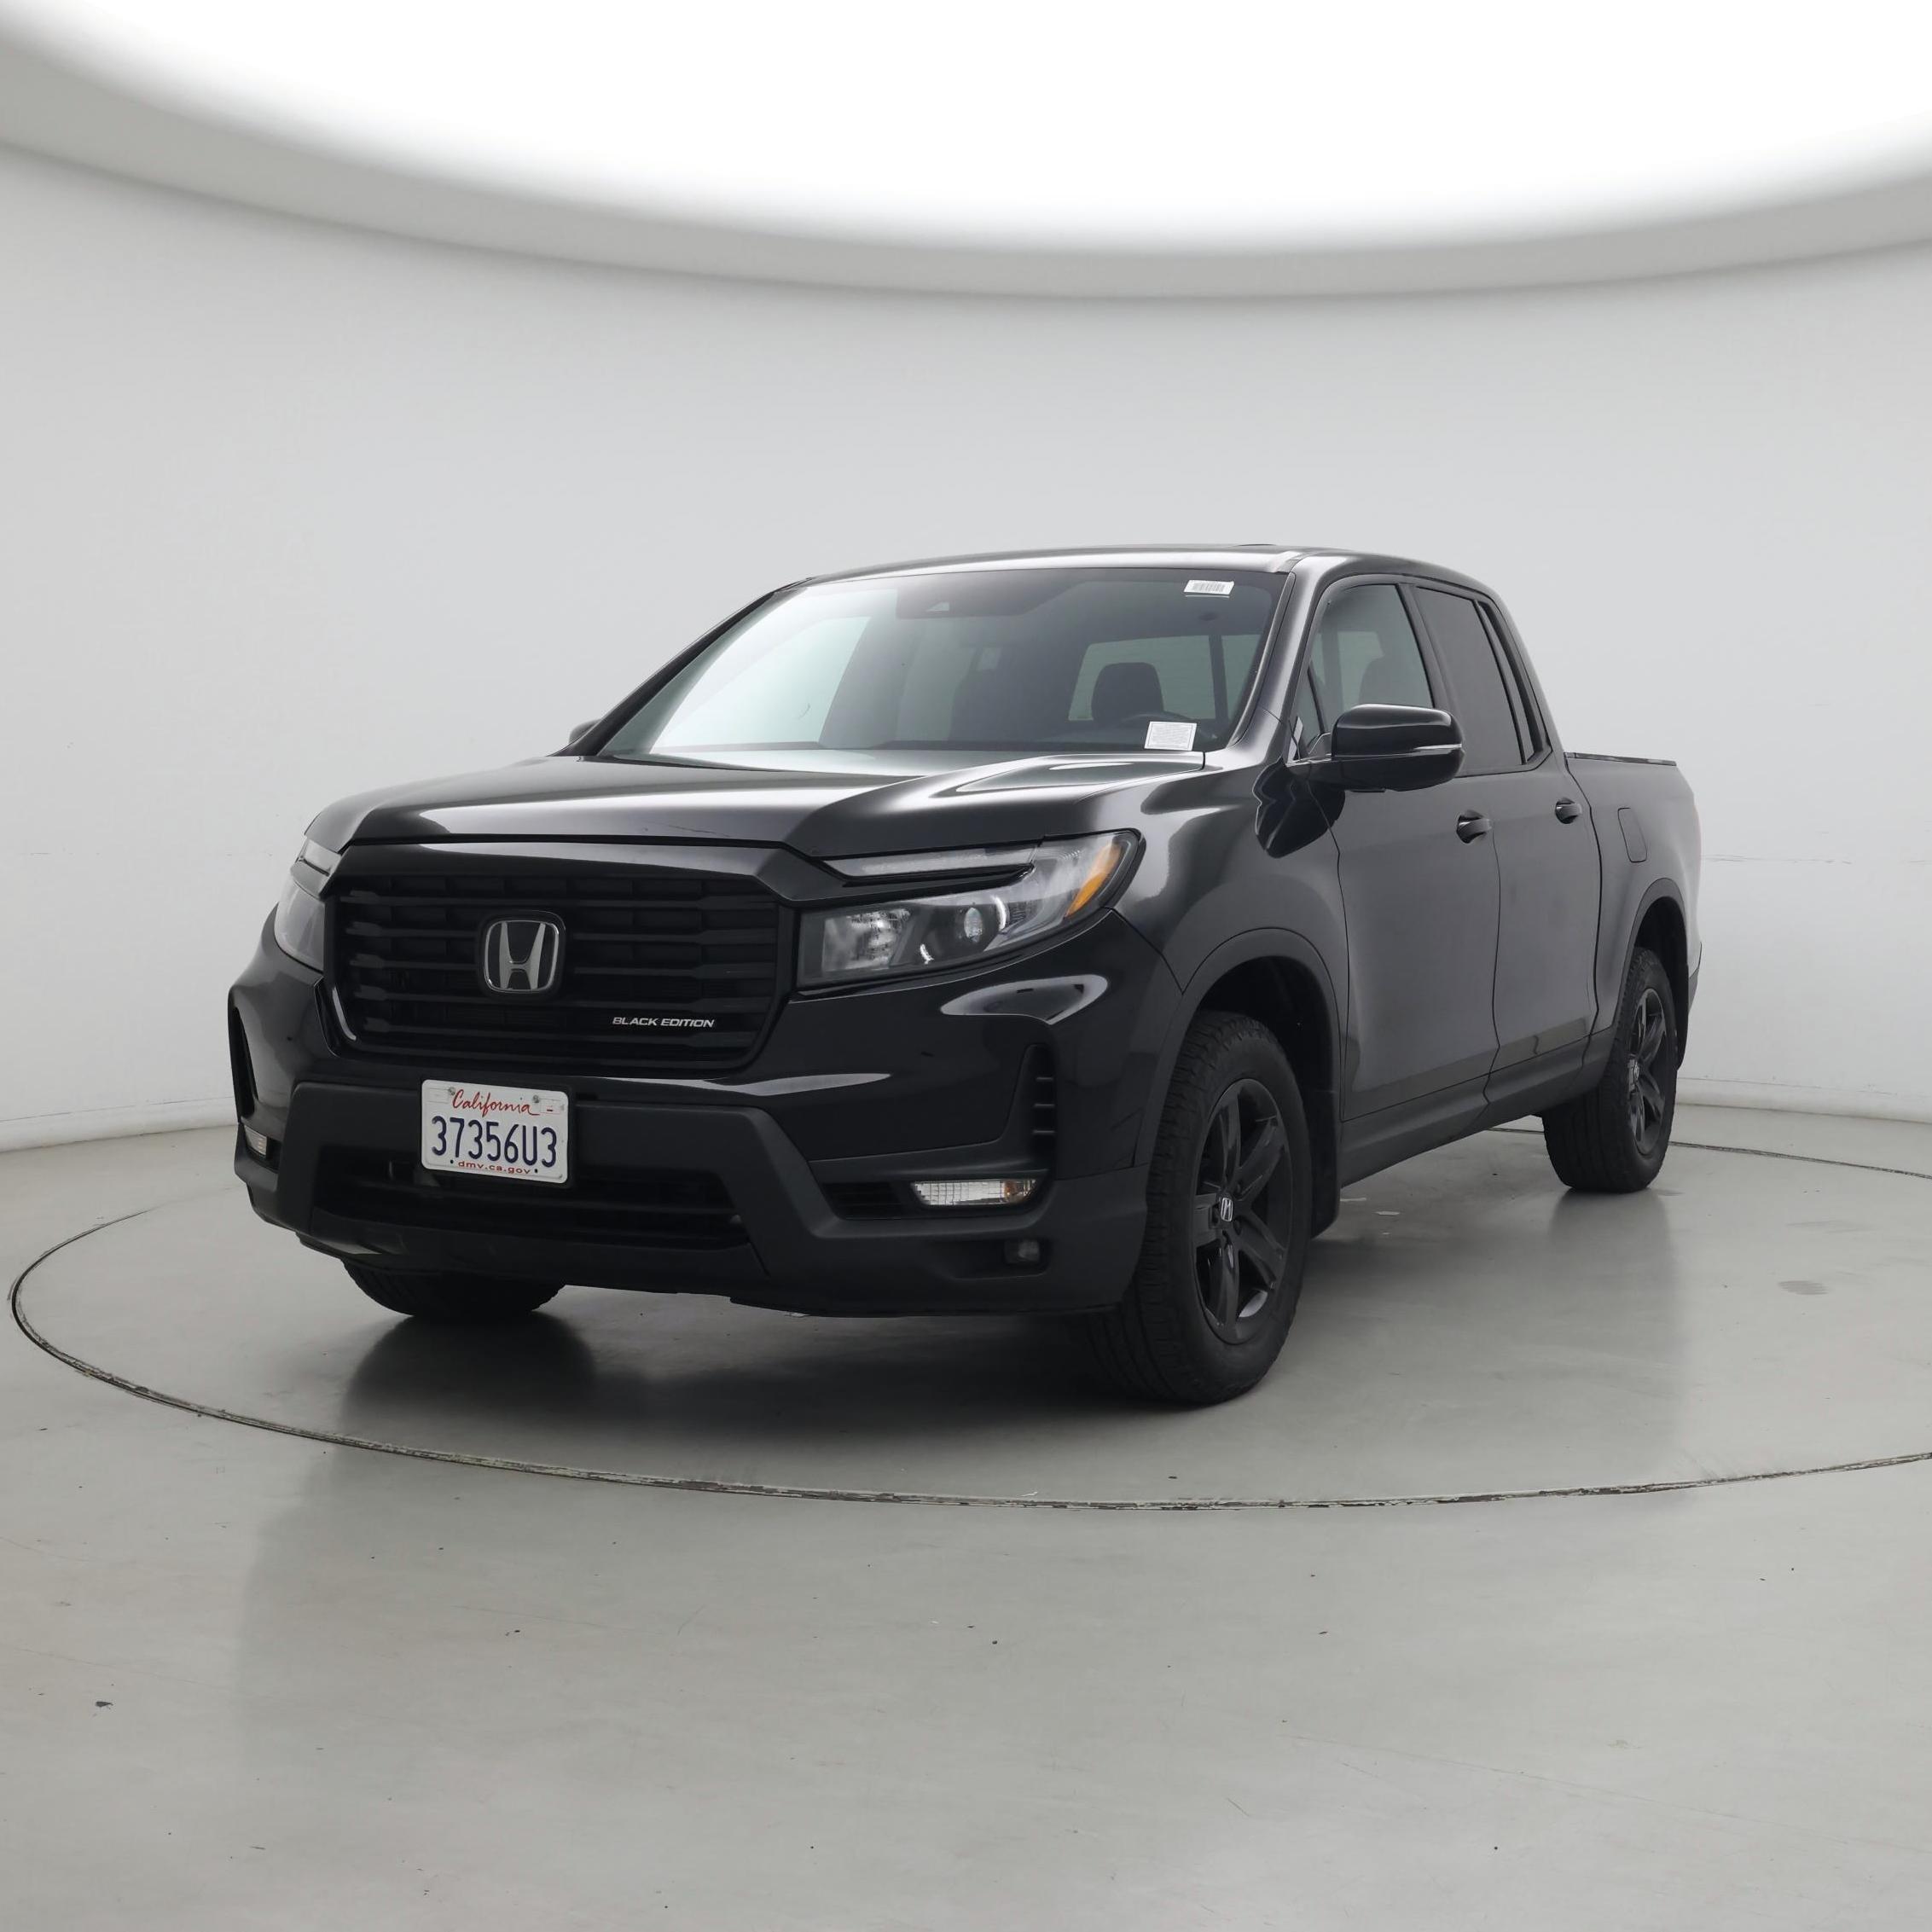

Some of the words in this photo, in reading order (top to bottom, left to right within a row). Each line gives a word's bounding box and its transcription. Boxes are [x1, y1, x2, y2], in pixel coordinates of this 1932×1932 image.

[612, 1017, 659, 1026] BLACK
[660, 1018, 715, 1028] EDITION
[452, 1089, 540, 1117] California
[432, 1116, 557, 1168] 37356U3
[458, 1160, 531, 1175] dmv.ca.gov
